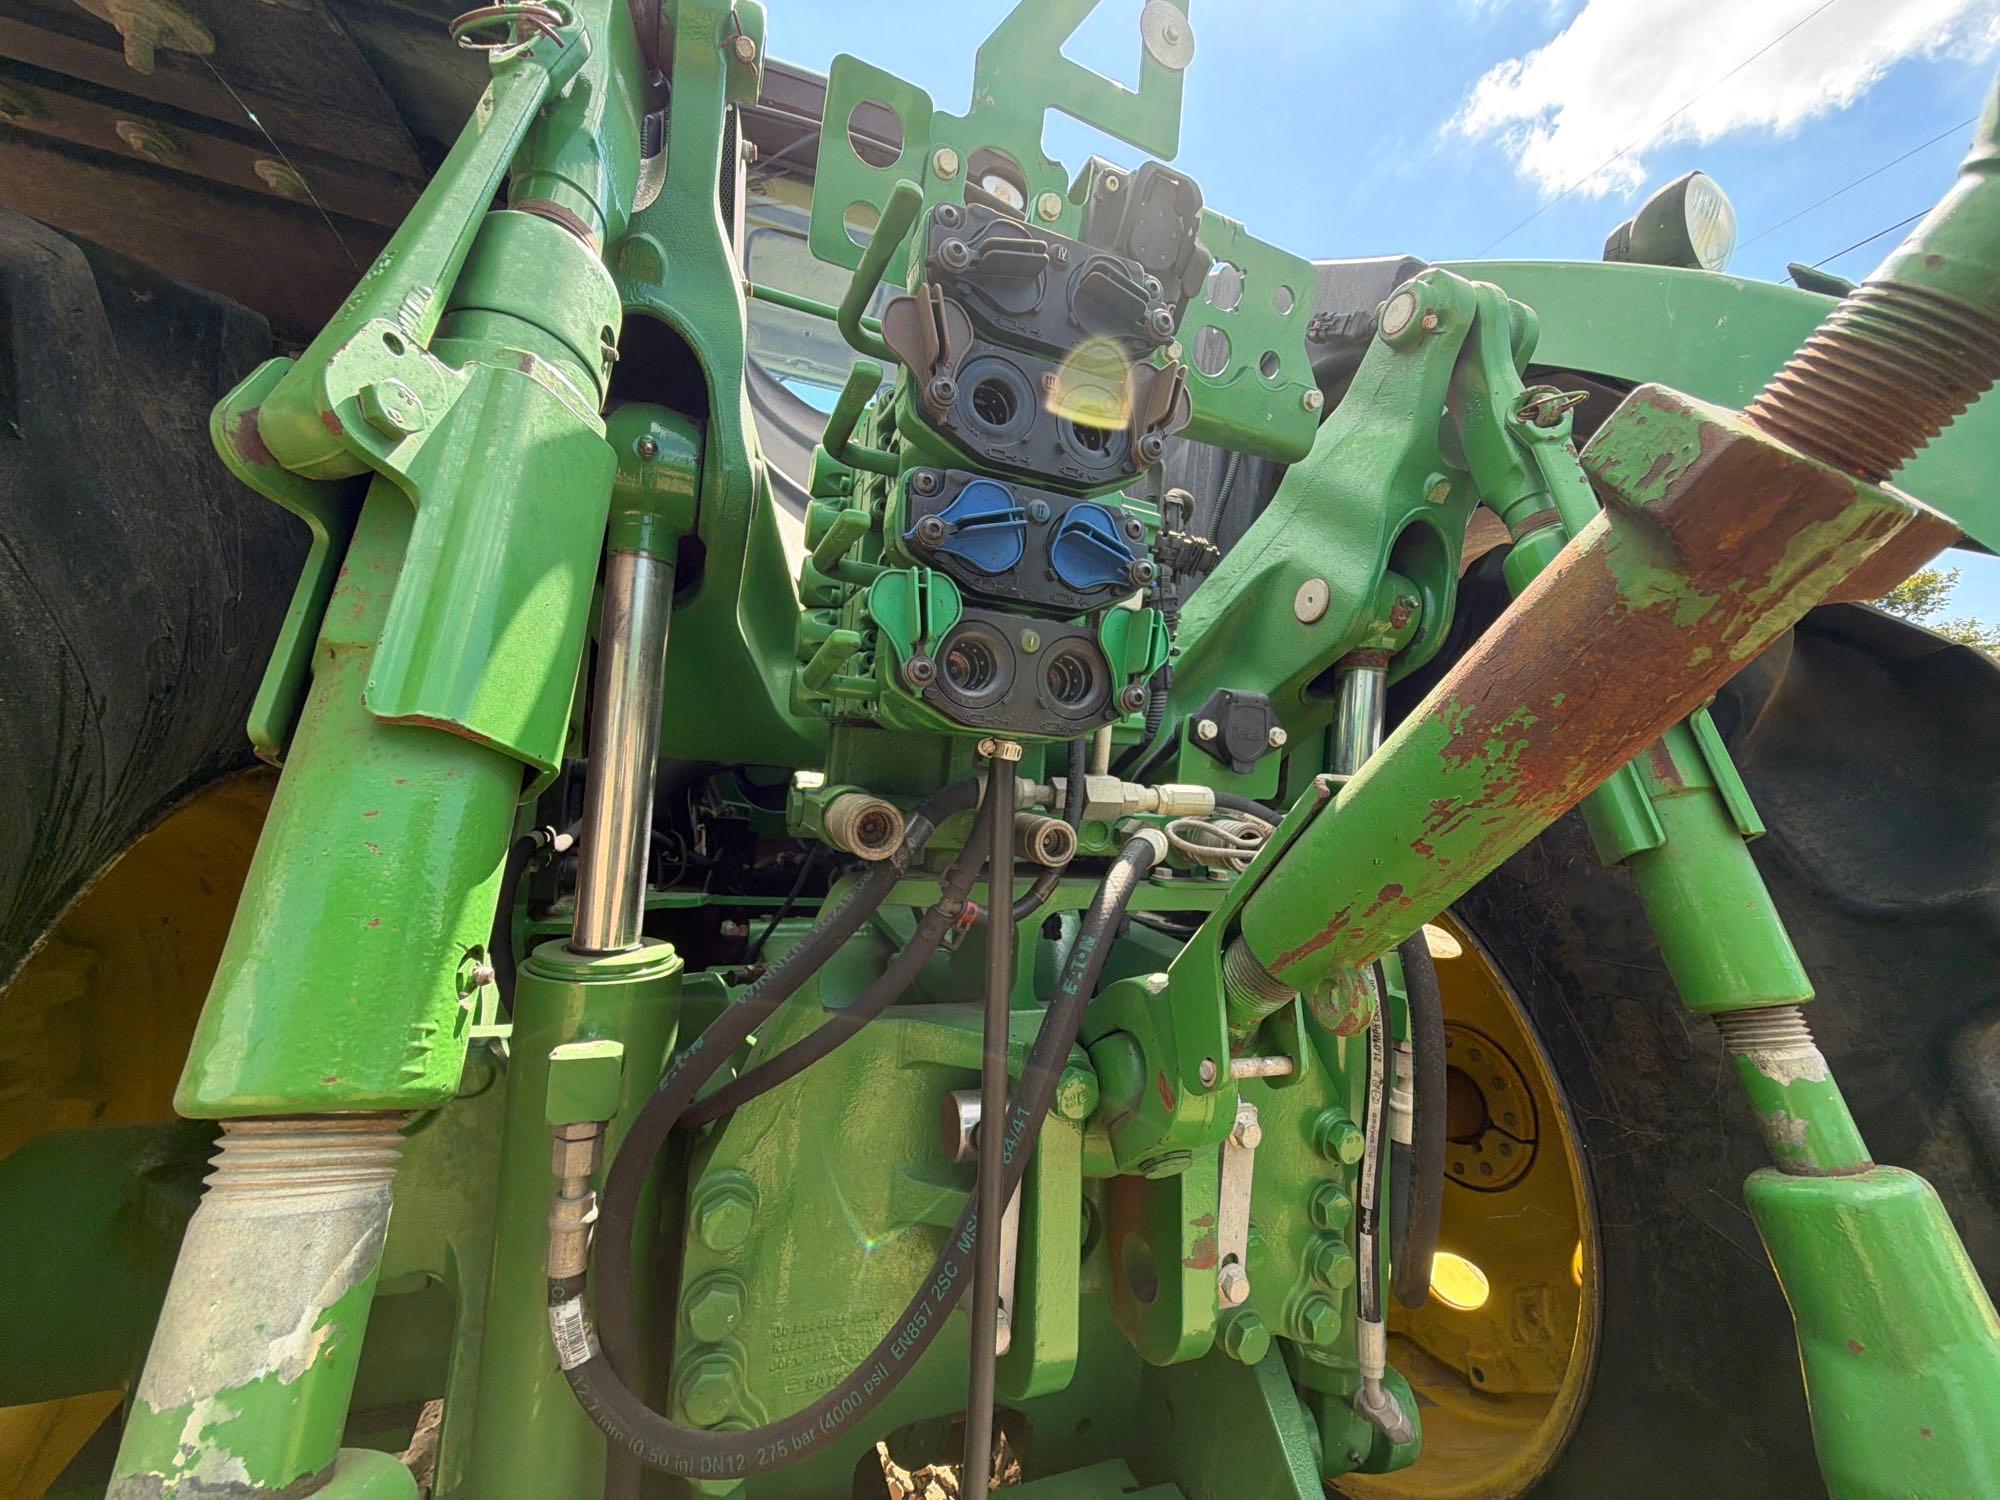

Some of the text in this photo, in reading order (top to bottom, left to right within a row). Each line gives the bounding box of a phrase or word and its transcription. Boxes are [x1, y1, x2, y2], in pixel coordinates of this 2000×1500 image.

[700, 1453, 746, 1474] DN12
[756, 1441, 789, 1467] 275
[790, 1427, 817, 1450] bar
[818, 1390, 863, 1434] (4000
[890, 1300, 934, 1361] EN857
[931, 1260, 959, 1301] 2SC
